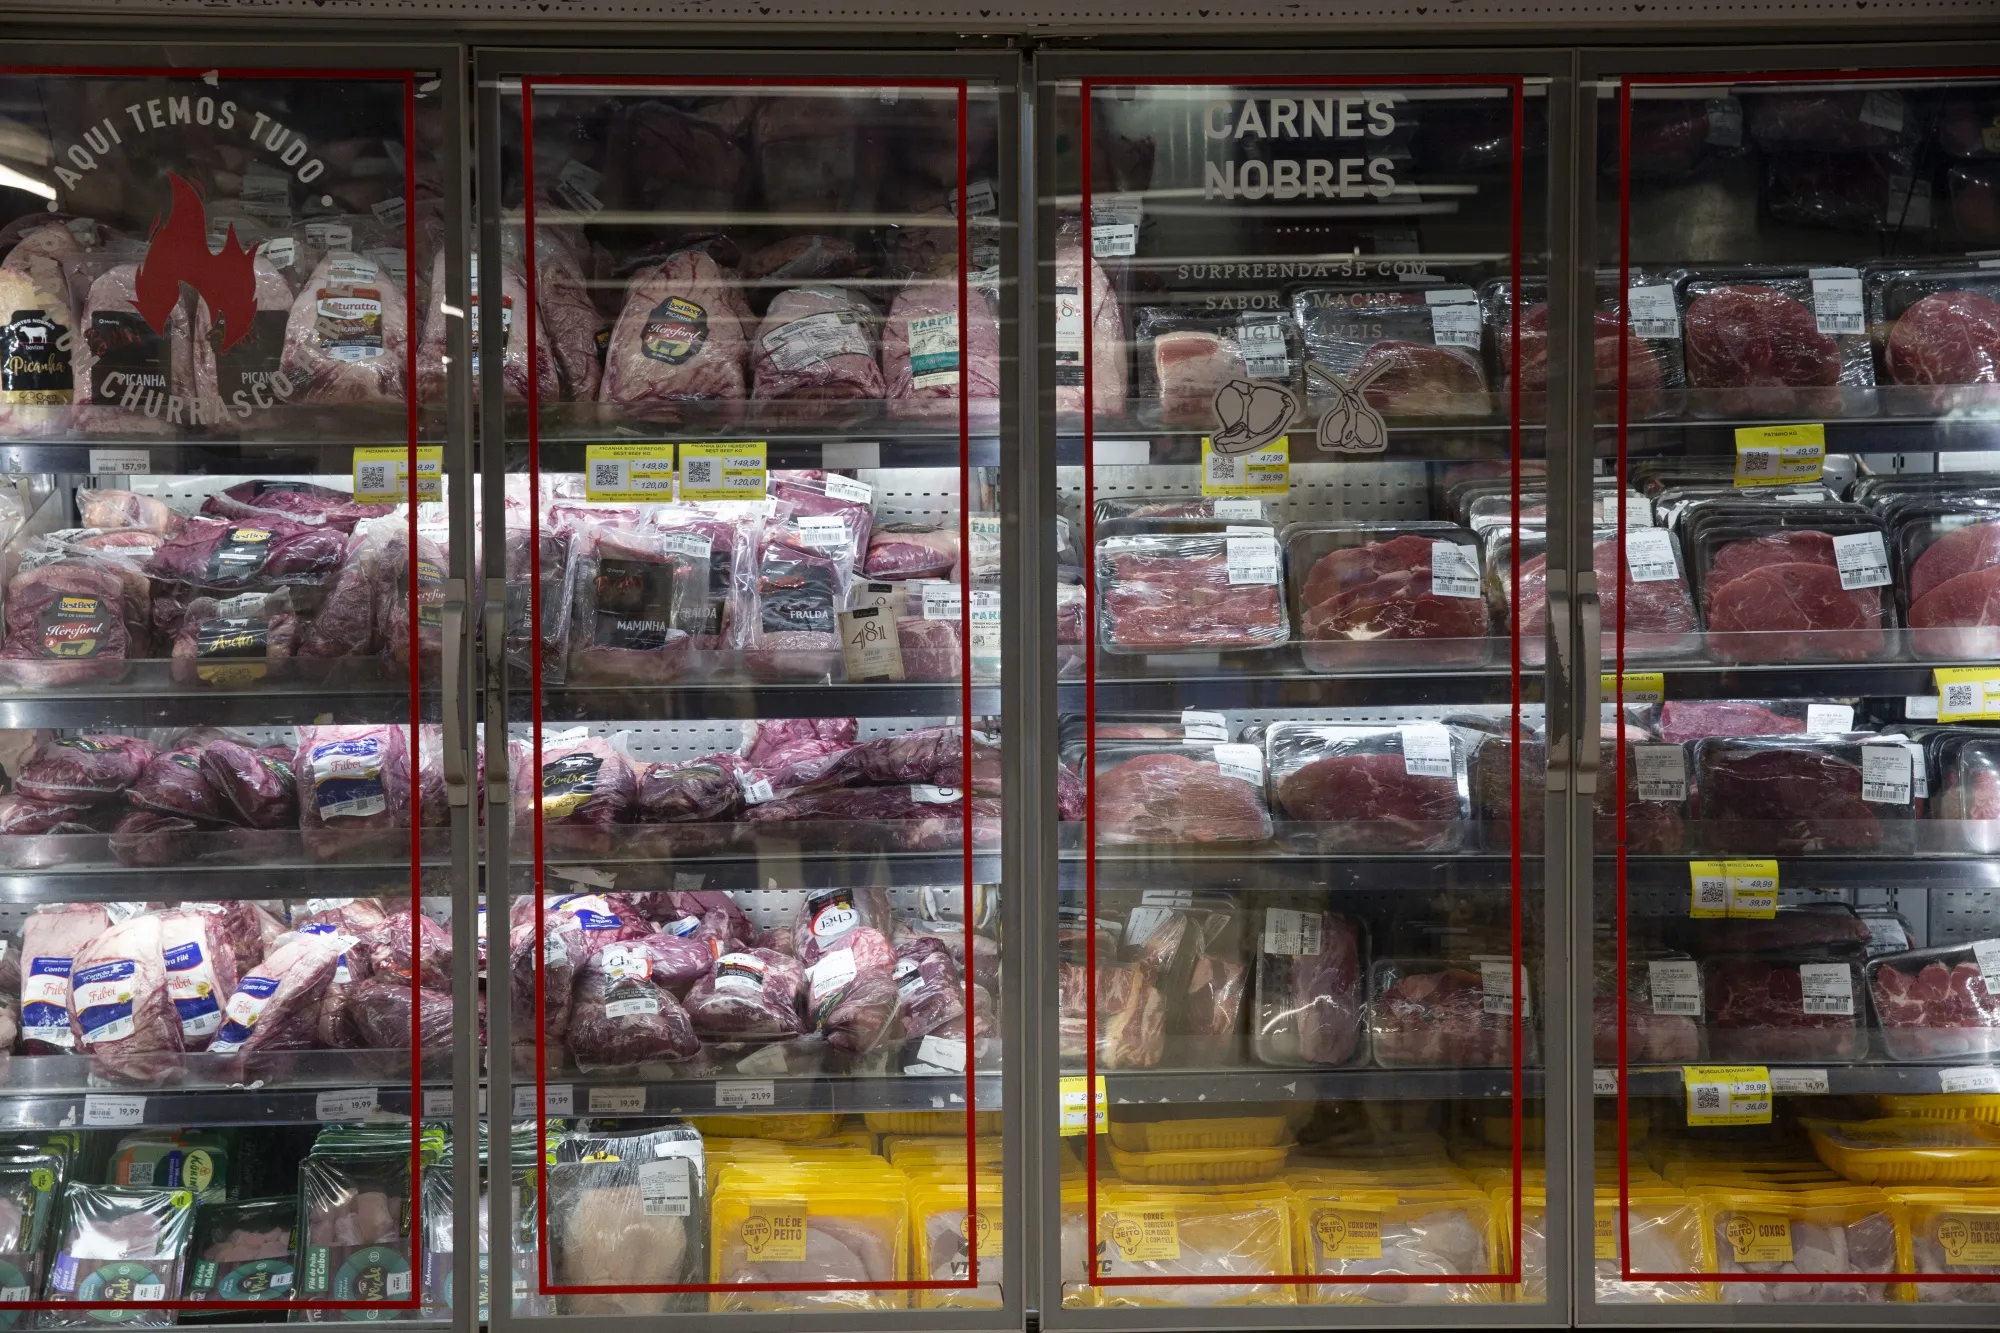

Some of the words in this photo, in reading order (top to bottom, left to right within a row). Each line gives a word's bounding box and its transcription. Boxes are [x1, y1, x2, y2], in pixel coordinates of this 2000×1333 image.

[1204, 97, 1396, 140] CARNES
[53, 117, 122, 191] AQUI
[125, 96, 237, 133] TEMOS
[249, 111, 325, 184] TUDO
[1204, 157, 1396, 200] NOBRES
[1177, 260, 1367, 281] SURPREENDA-SE
[1377, 260, 1429, 277] COM
[1205, 294, 1281, 311] SABOR
[1313, 292, 1402, 309] MACIEZ
[665, 310, 692, 323] PICANHA
[648, 323, 702, 341] Hereford
[10, 353, 64, 376] Picanha
[119, 373, 166, 387] PICANHA
[100, 371, 294, 425] CHURRASCO
[1796, 447, 1819, 456] 49,99
[733, 459, 760, 467] 149,99
[1260, 454, 1283, 463] 47,99
[121, 462, 147, 472] 157,99
[641, 462, 669, 471] 149,99
[1794, 464, 1817, 473] 39,99
[733, 478, 760, 487] 120,00
[1260, 473, 1283, 482] 39,99
[641, 481, 669, 490] 120,00
[59, 600, 98, 610] BestBeef
[790, 610, 829, 620] FRALDA
[46, 622, 103, 639] Hereford
[617, 620, 666, 632] MAMINHA
[851, 620, 887, 650] 481
[210, 632, 255, 652] Ancho
[1635, 692, 1659, 701] 49,99
[330, 758, 361, 773] Friboi
[542, 773, 587, 787] Contra
[1750, 880, 1774, 889] 49,99
[1749, 898, 1772, 908] 39,99
[176, 952, 189, 963] Filé
[43, 965, 69, 974] Contra
[88, 987, 116, 1003] Friboi
[1594, 1083, 1615, 1091] 14,99
[1744, 1082, 1767, 1091] 39,99
[1805, 1082, 1825, 1091] 14,99
[1972, 1077, 1994, 1087] 22,99
[548, 1096, 568, 1106] 19,99
[751, 1092, 771, 1101] 21,99
[351, 1100, 372, 1110] 19,99
[620, 1099, 640, 1108] 19,99
[1745, 1102, 1768, 1111] 36,89
[119, 1108, 140, 1117] 19,99
[774, 1215, 790, 1228] FILÉ
[791, 1217, 802, 1228] DE
[1347, 1221, 1362, 1229] COXA
[1363, 1221, 1378, 1229] COM
[743, 1227, 769, 1237] JEITO
[1115, 1229, 1140, 1239] JEITO
[1318, 1225, 1344, 1234] JEITO
[1728, 1229, 1753, 1238] JEITO
[1759, 1224, 1786, 1238] COXAS
[774, 1229, 802, 1241] PEITO
[1940, 1231, 1965, 1240] JEITO
[1970, 1231, 1983, 1245] DA
[309, 1252, 317, 1268] Peito
[317, 1248, 326, 1274] Cubos
[205, 1262, 216, 1279] Cubos
[308, 1277, 317, 1290] Filé
[318, 1274, 326, 1290] em
